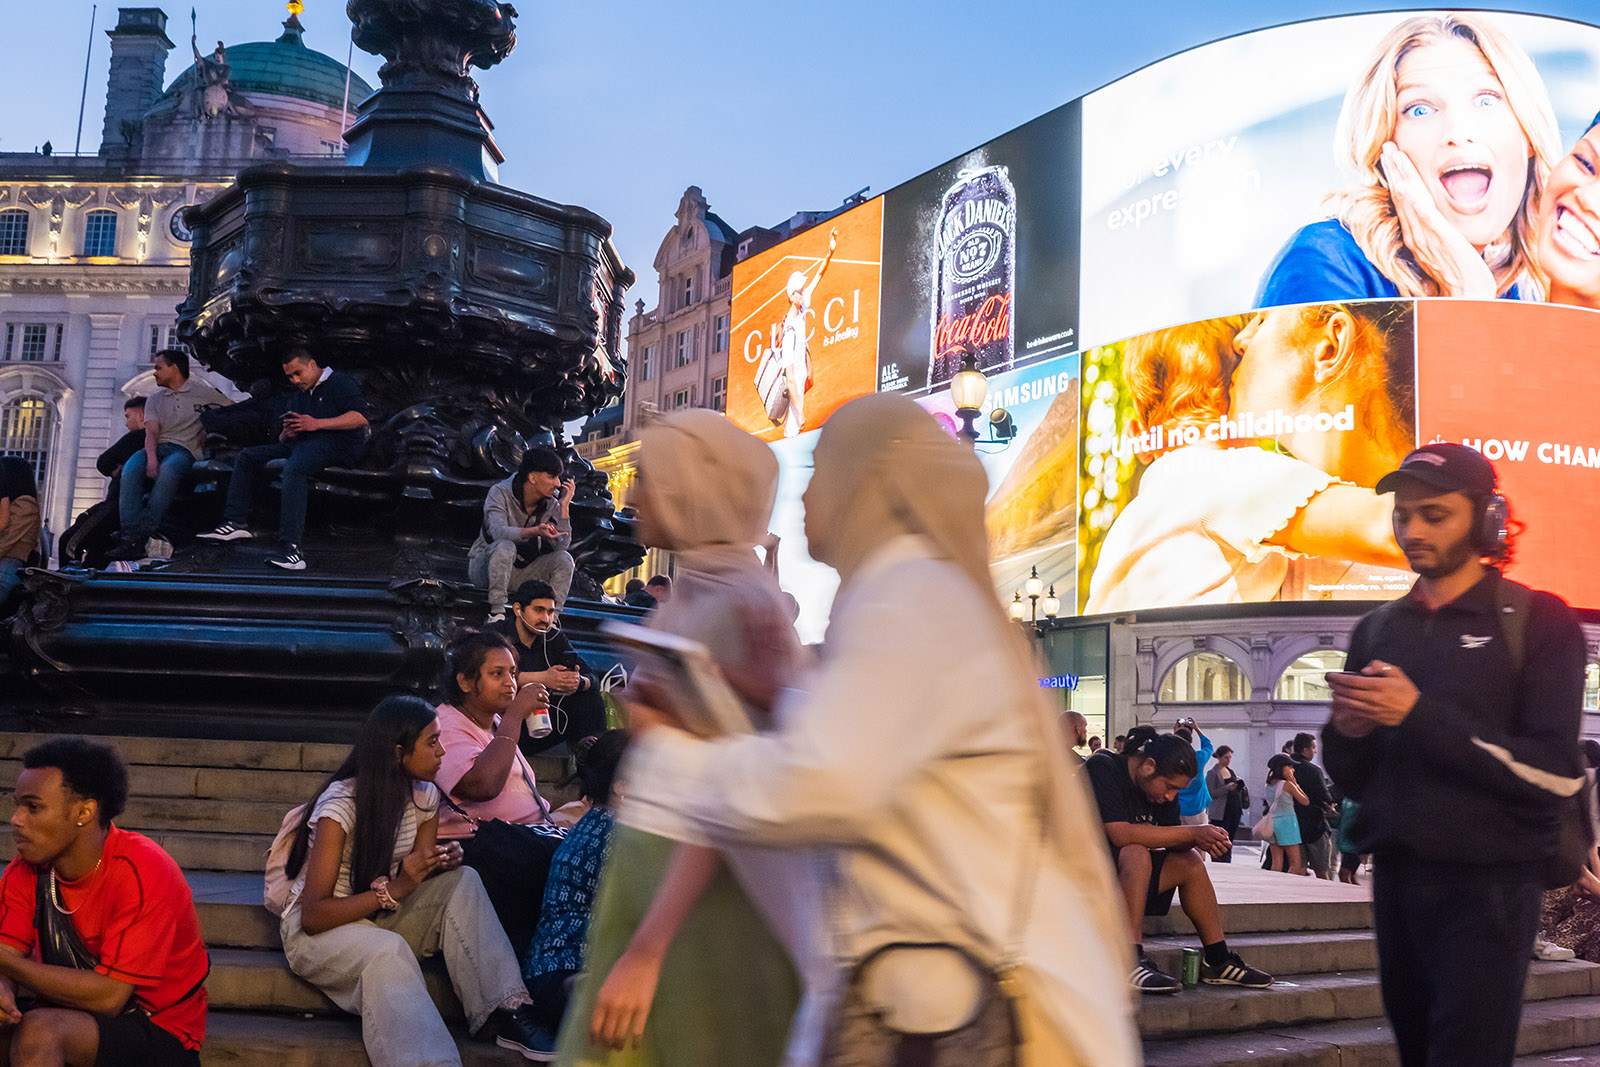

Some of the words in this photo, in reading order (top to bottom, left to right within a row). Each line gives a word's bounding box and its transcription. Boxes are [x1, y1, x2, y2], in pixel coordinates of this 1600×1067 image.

[1153, 136, 1238, 177] every
[1107, 168, 1260, 230] expren
[939, 209, 965, 260] JACK
[962, 258, 985, 271] BRAND
[829, 335, 835, 345] a
[835, 326, 859, 343] feeling
[935, 292, 1011, 360] Coca-Cola
[981, 371, 1069, 415] SAMSUNG
[1111, 425, 1163, 458] Until
[1168, 425, 1200, 448] no
[1204, 404, 1354, 440] childhood
[1462, 438, 1530, 462] HOW
[1537, 442, 1600, 469] CHAM
[1308, 583, 1345, 592] Registered
[1345, 583, 1369, 592] charity
